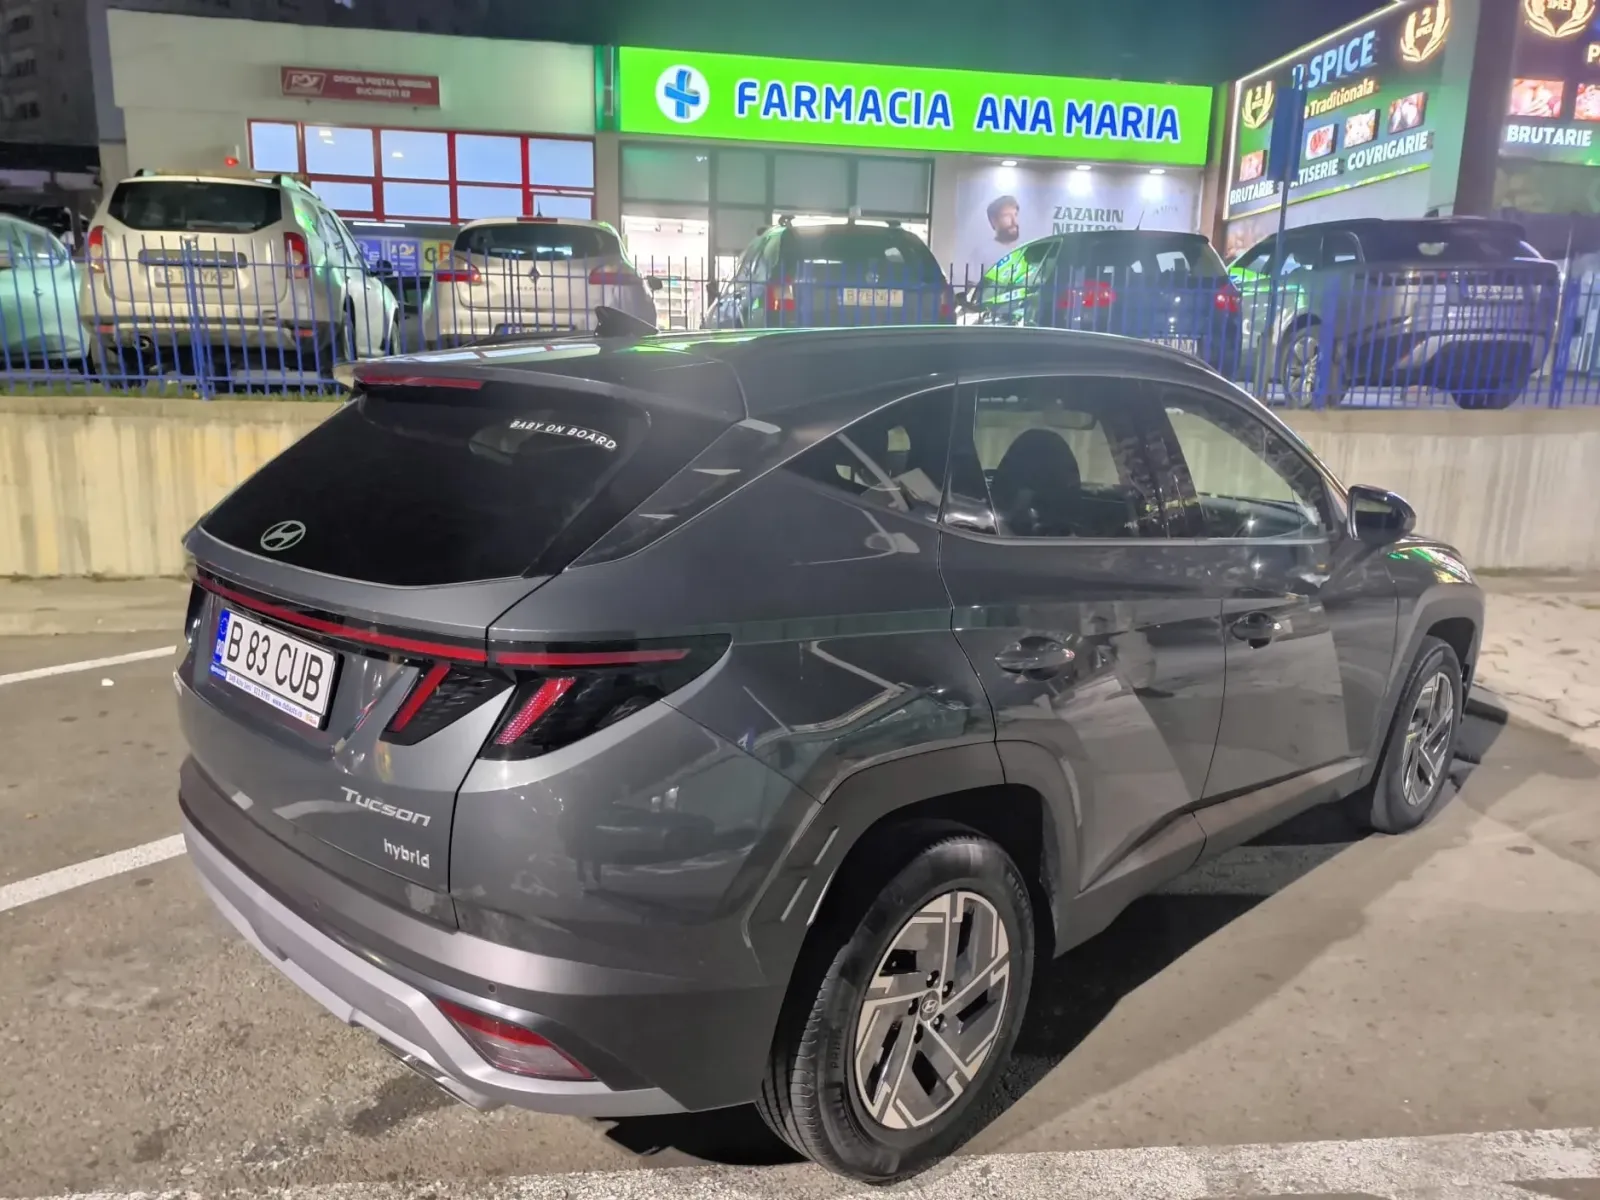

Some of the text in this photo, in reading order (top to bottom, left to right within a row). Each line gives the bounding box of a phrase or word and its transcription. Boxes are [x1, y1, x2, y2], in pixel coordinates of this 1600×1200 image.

[1307, 29, 1376, 89] SPICE
[736, 80, 1179, 141] FARMACIA ANA MARIA
[1309, 77, 1375, 117] Traditionala
[1506, 124, 1593, 147] BRUTARIE
[1229, 129, 1429, 206] BRUTARIE TISERIE COVRIGARIE
[1053, 205, 1124, 223] ZAZARIN
[509, 420, 617, 449] BABY ON BOARD
[227, 620, 324, 701] B 83 CUB
[383, 838, 430, 869] hybrid
